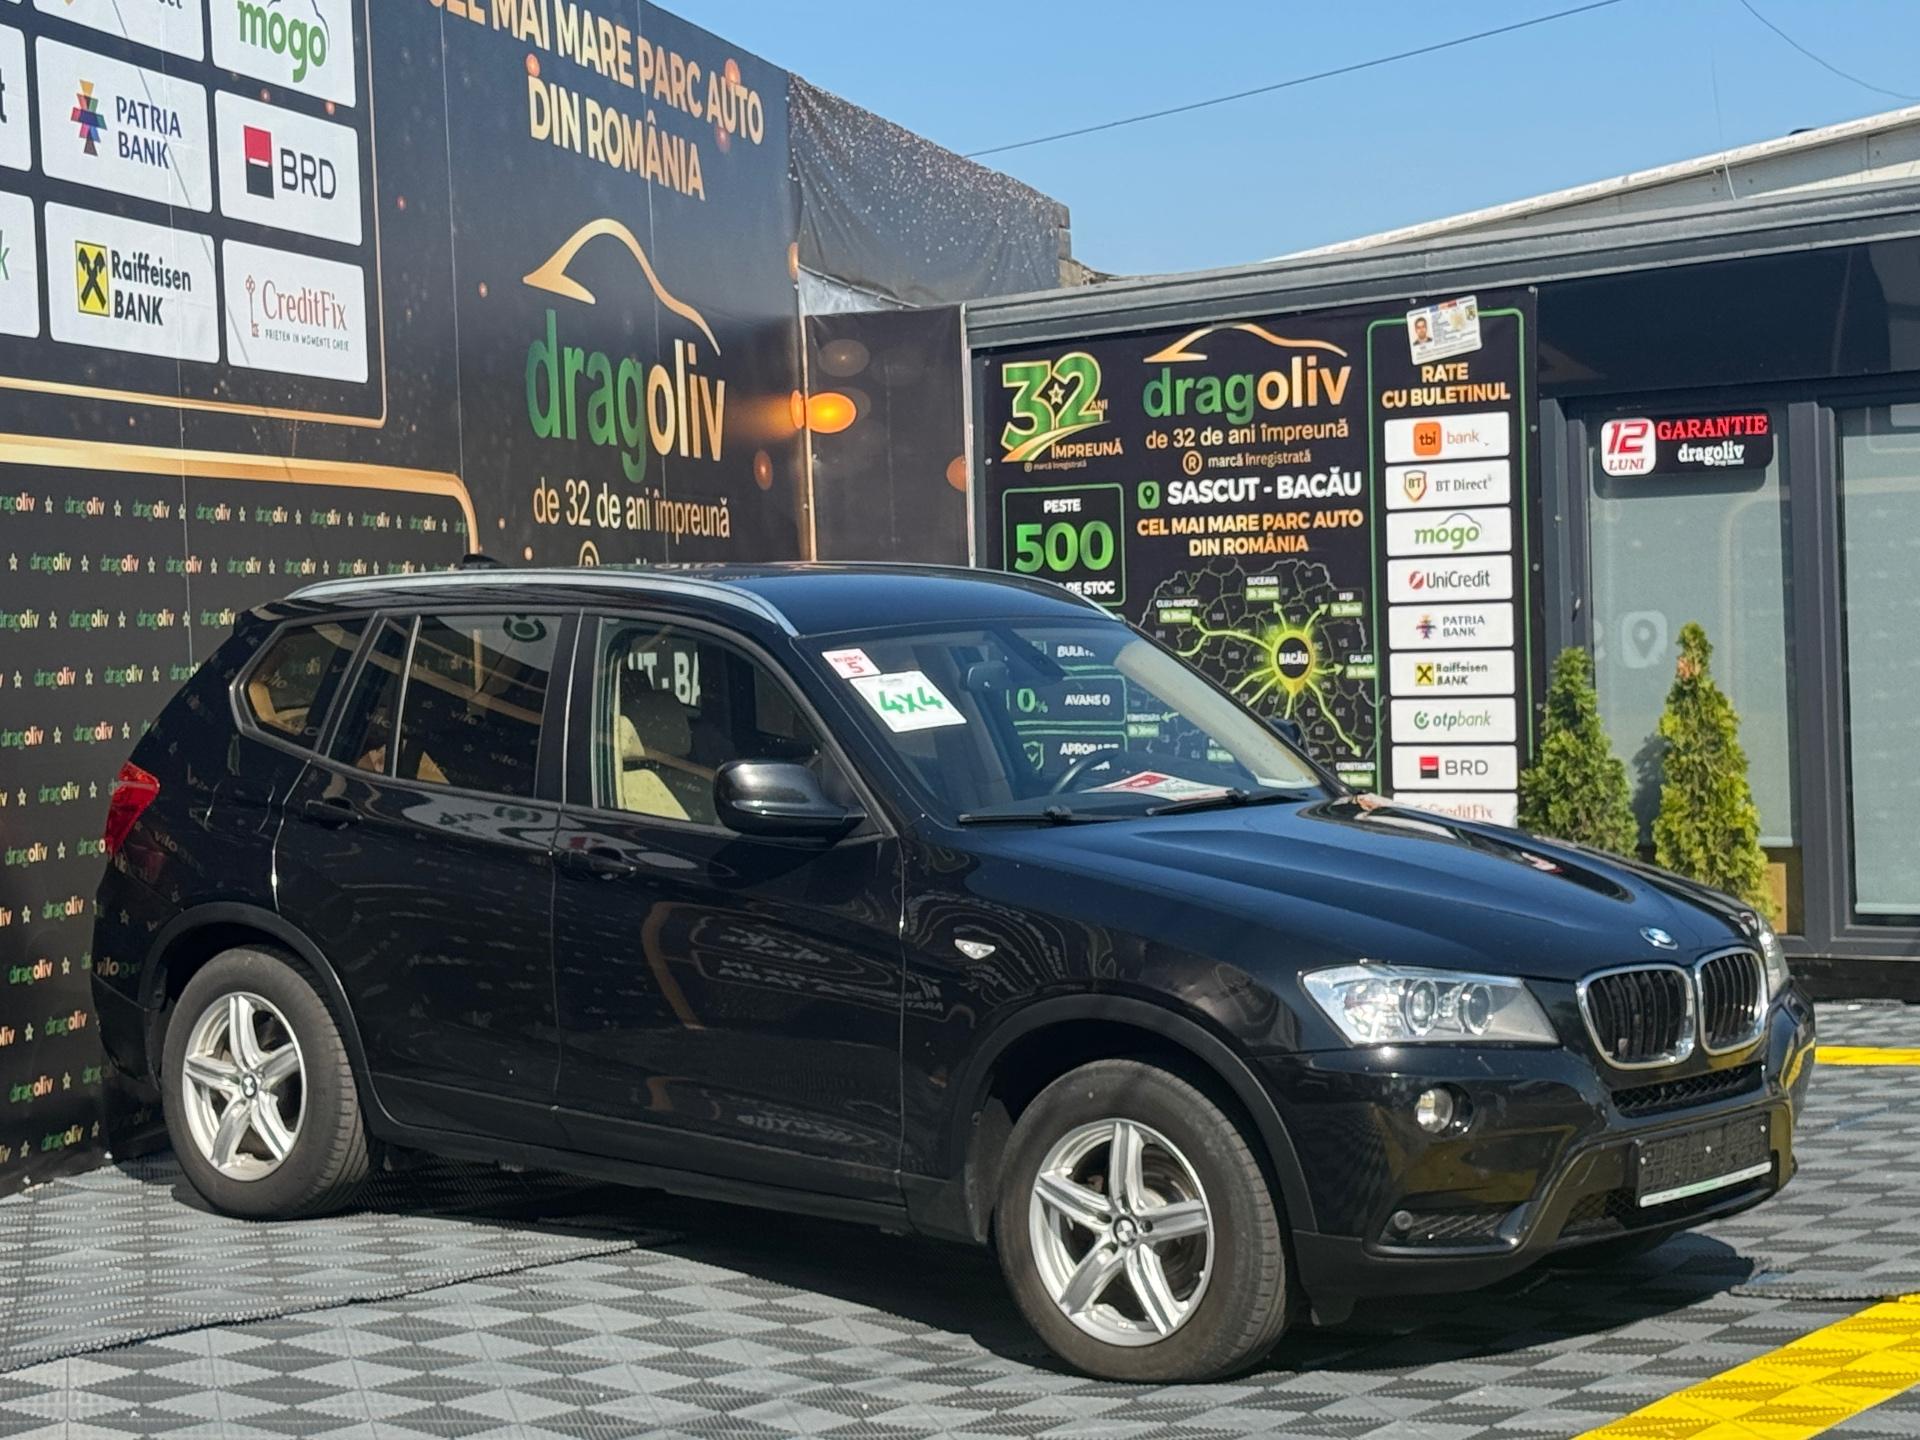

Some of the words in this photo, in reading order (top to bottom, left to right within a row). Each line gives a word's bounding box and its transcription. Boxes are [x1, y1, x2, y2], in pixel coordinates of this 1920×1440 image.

[238, 0, 327, 83] mogo
[491, 0, 550, 51] MAI
[555, 3, 634, 89] MARE
[637, 35, 703, 118] PARC
[706, 71, 764, 145] AUTO
[116, 96, 182, 138] PATRIA
[118, 131, 170, 170] BANK
[528, 75, 581, 154] DIN
[586, 98, 705, 201] ROMÂNIA
[280, 147, 337, 200] BRD
[111, 250, 191, 292] Raiffeisen
[114, 290, 163, 325] BANK
[263, 280, 347, 331] CreditFix
[1421, 362, 1469, 383] RATE
[526, 308, 725, 483] dragoliv
[1142, 355, 1351, 424] dragoliv
[1382, 391, 1407, 409] CU
[1410, 382, 1511, 407] BULETINUL
[1145, 430, 1169, 450] de
[1172, 427, 1196, 448] 32
[1200, 426, 1224, 446] de
[1227, 422, 1256, 443] ani
[1260, 419, 1349, 446] împreună
[1419, 431, 1436, 446] tbi
[1447, 430, 1479, 444] bank
[1608, 421, 1648, 454] 12
[1657, 415, 1768, 441] GARANTIE
[1208, 452, 1243, 468] marcă
[1609, 458, 1645, 471] LUNI
[1678, 440, 1744, 466] dragoliv
[1167, 477, 1260, 504] SASCUT
[1276, 467, 1363, 500] BACĂU
[1436, 480, 1451, 491] BT
[1453, 479, 1488, 491] Direct
[0, 492, 35, 515] ragoliv
[64, 496, 105, 518] dragoliv
[132, 500, 170, 522] dragoliv
[195, 503, 232, 524] dragoliv
[255, 505, 289, 527] dragoliv
[310, 508, 341, 529] dragoliv
[361, 512, 390, 531] dragoliv
[409, 515, 437, 532] dragoliv
[533, 476, 560, 525] de
[565, 478, 591, 527] 32
[596, 482, 621, 529] de
[626, 487, 650, 531] ani
[655, 490, 730, 545] împreună
[1043, 498, 1082, 513] PESTE
[1136, 518, 1169, 536] CEL
[1171, 516, 1206, 534] MAI
[1208, 514, 1260, 532] MARE
[1262, 511, 1310, 530] PARC
[1313, 509, 1364, 528] AUTO
[1014, 520, 1114, 573] 500
[1189, 538, 1222, 557] DIN
[1223, 531, 1309, 555] ROMÂNIA
[1415, 525, 1480, 550] mogo
[30, 552, 72, 576] dragoliv
[100, 554, 140, 577] dragoliv
[165, 555, 203, 577] dragoliv
[226, 556, 262, 578] dragoliv
[284, 557, 317, 578] dragoliv
[337, 558, 368, 577] dragoliv
[1083, 580, 1115, 595] STOC
[1426, 570, 1490, 588] UniCredit
[69, 609, 110, 632] dragoliv
[136, 608, 175, 631] dragoliv
[200, 608, 236, 629] dragoliv
[1442, 616, 1485, 626] PATRIA
[1442, 627, 1476, 637] BANK
[33, 666, 76, 690] dragoliv
[104, 664, 144, 687] dragoliv
[1436, 663, 1488, 674] Raiffeisen
[1436, 676, 1468, 686] BANK
[1065, 694, 1101, 706] AVANS
[1433, 710, 1492, 731] otpbank
[1, 725, 44, 750] dragoliv
[73, 720, 113, 744] dragoliv
[1445, 760, 1488, 775] BRD
[38, 781, 80, 805] dragoliv
[4, 841, 48, 868] dragoliv
[77, 837, 106, 857] drago
[42, 895, 84, 921] dragoliv
[9, 959, 53, 985] dragoliv
[45, 1009, 87, 1036] dragoliv
[9, 1075, 54, 1103] dragoliv
[41, 1124, 83, 1150] dragoliv
